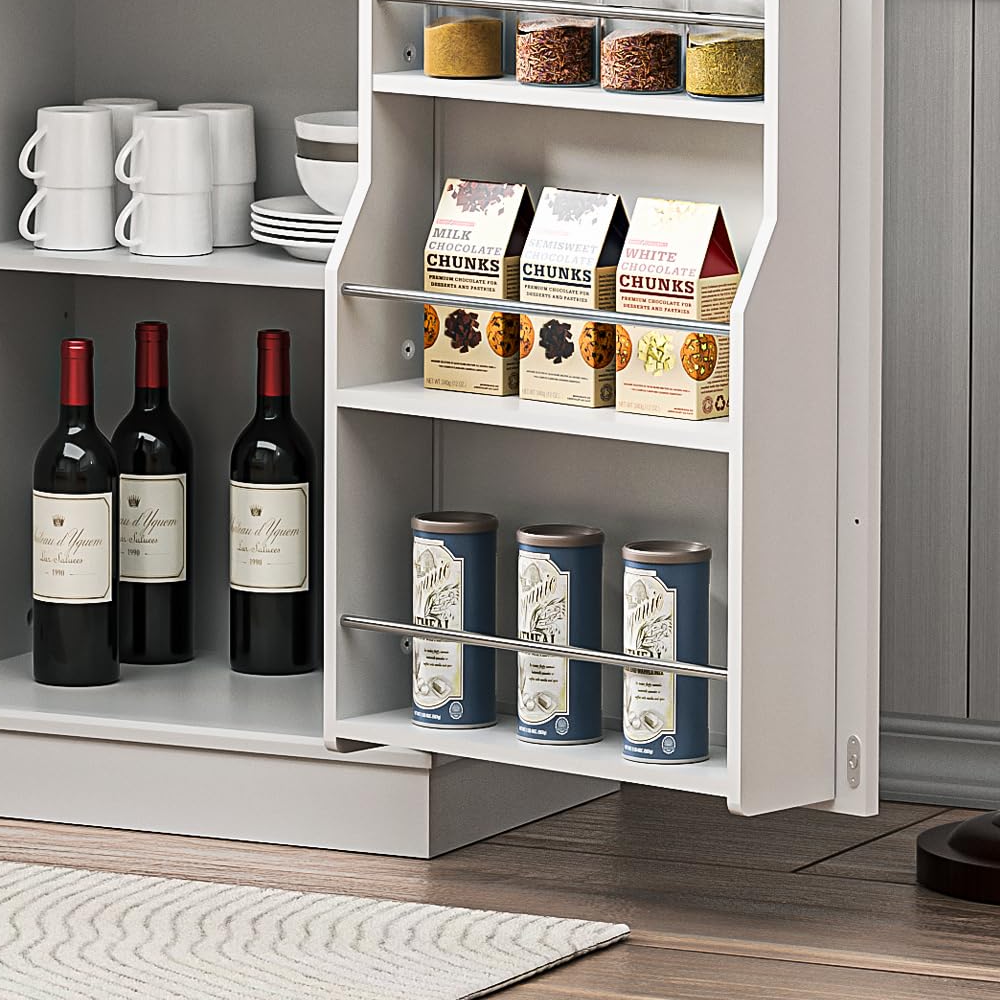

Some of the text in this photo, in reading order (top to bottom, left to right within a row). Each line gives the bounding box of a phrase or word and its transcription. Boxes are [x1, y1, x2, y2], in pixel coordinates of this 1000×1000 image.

[432, 228, 472, 240] MILK
[429, 241, 502, 256] CHOCOLATE
[528, 238, 599, 254] SEMISWEET
[427, 253, 500, 272] CHUNKS
[524, 250, 595, 266] CHOCOLATE
[625, 247, 677, 263] WHITE
[523, 263, 592, 282] CHUNKS
[621, 262, 697, 277] CHOCOLATE
[455, 277, 486, 285] CHOCOLATE
[619, 274, 695, 294] CHUNKS
[549, 287, 578, 295] CHOCOLATE
[648, 298, 680, 307] CHOCOLATE
[664, 307, 690, 315] PASTRIES
